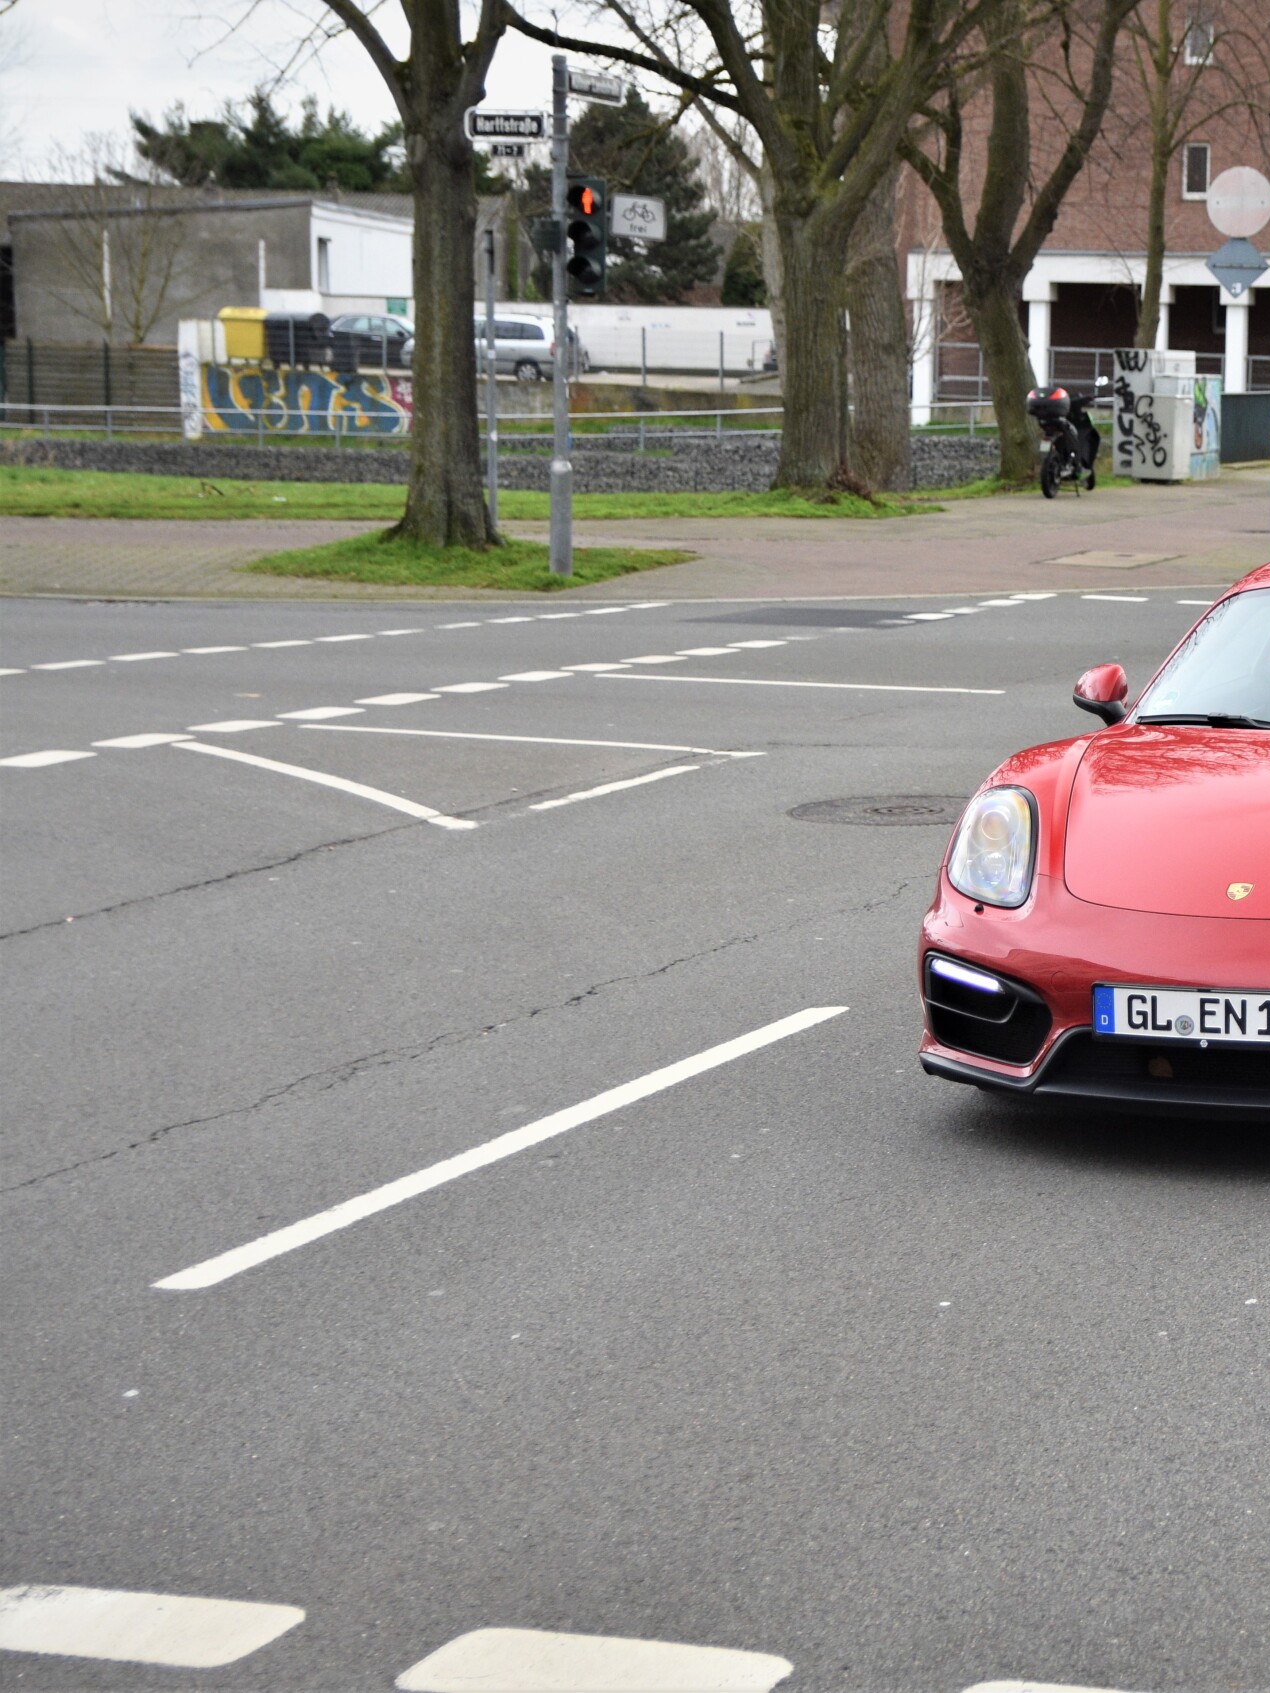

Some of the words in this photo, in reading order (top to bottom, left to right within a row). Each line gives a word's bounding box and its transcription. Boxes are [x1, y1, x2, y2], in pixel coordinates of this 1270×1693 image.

[1101, 1014, 1109, 1025] D
[1127, 994, 1172, 1031] GL
[1199, 998, 1247, 1035] EN
